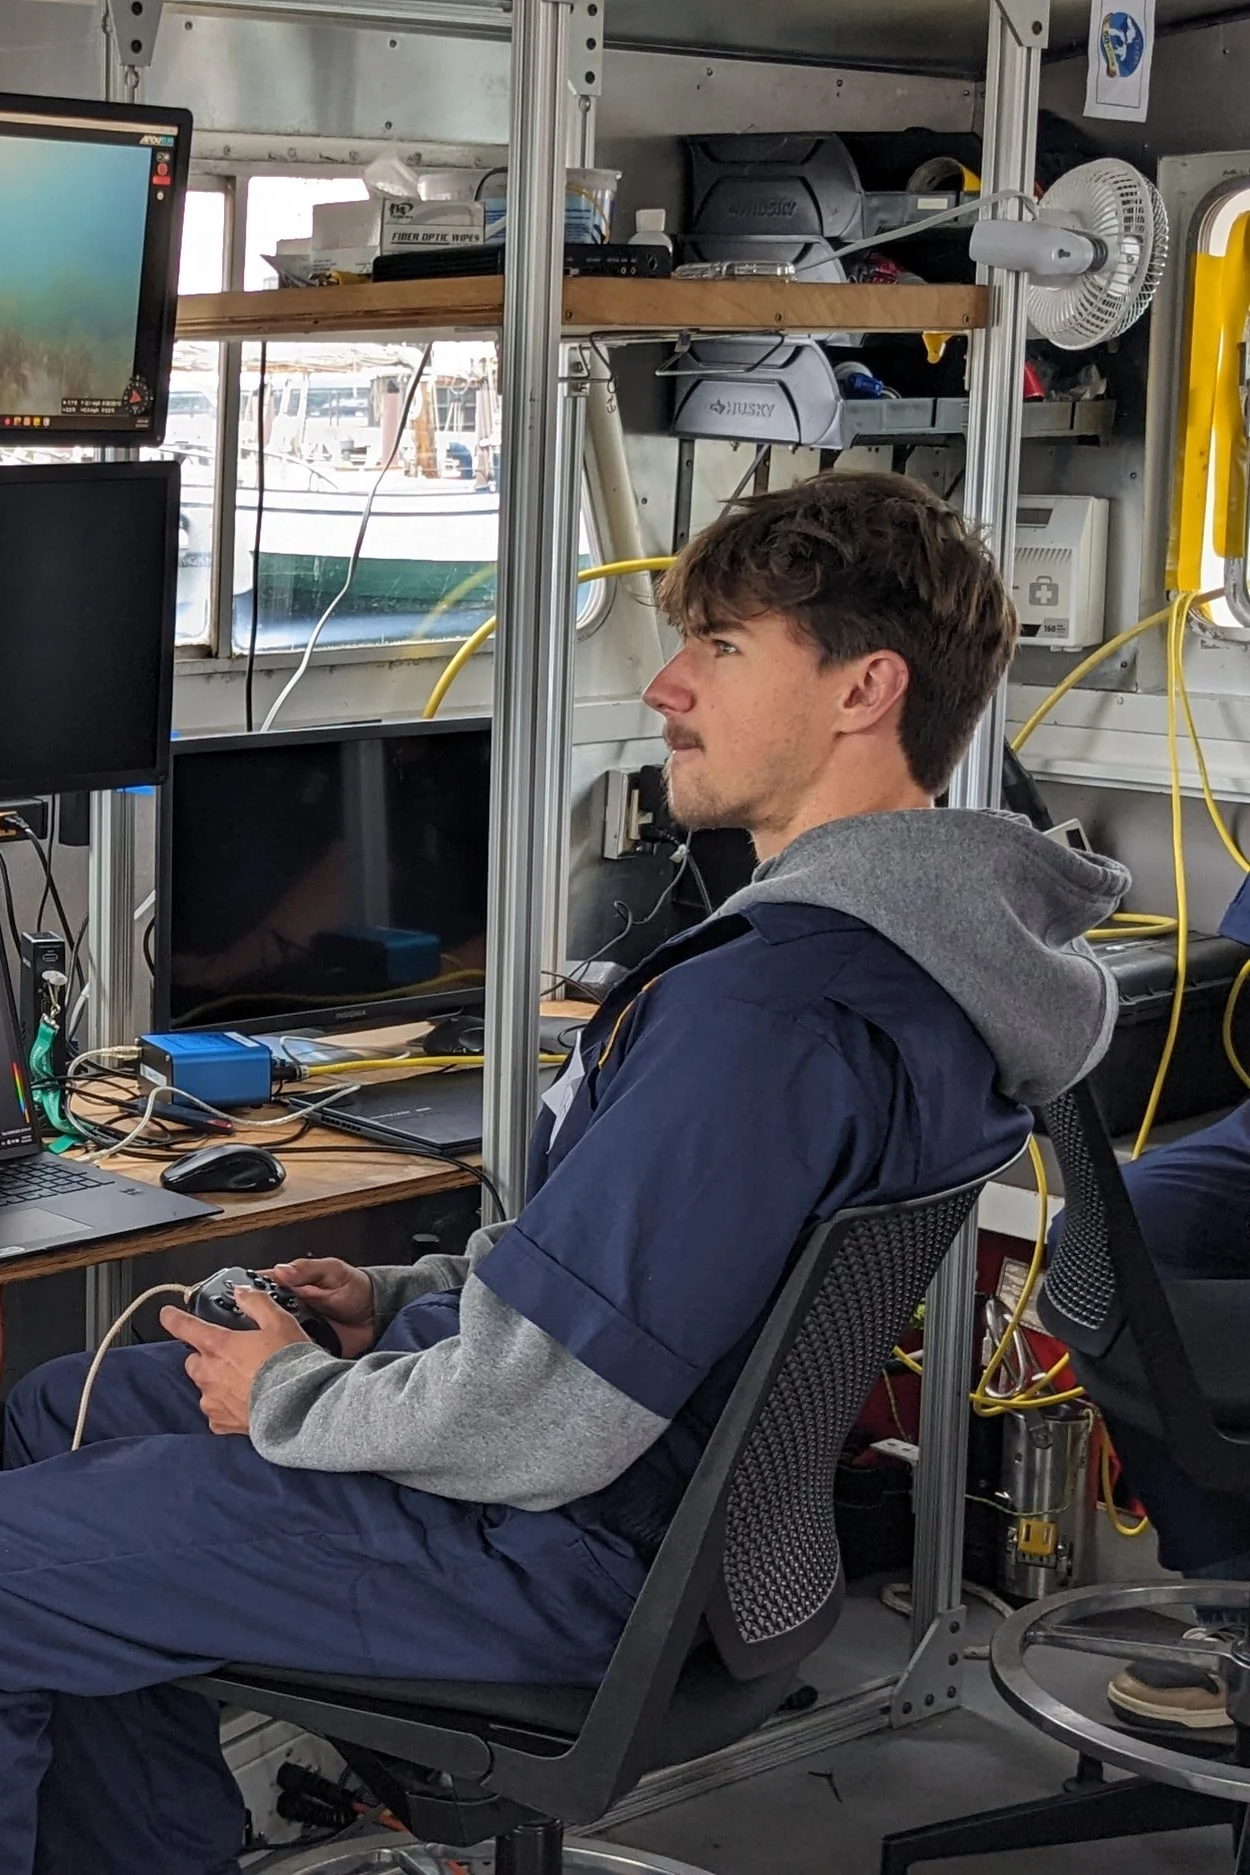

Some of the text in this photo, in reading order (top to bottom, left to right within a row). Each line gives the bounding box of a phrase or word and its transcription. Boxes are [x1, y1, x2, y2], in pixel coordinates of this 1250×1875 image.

[742, 199, 797, 218] HUSKY
[391, 232, 480, 242] FIBER OPTIC WIPES
[725, 401, 776, 418] HUSKY
[1044, 624, 1056, 632] 160
